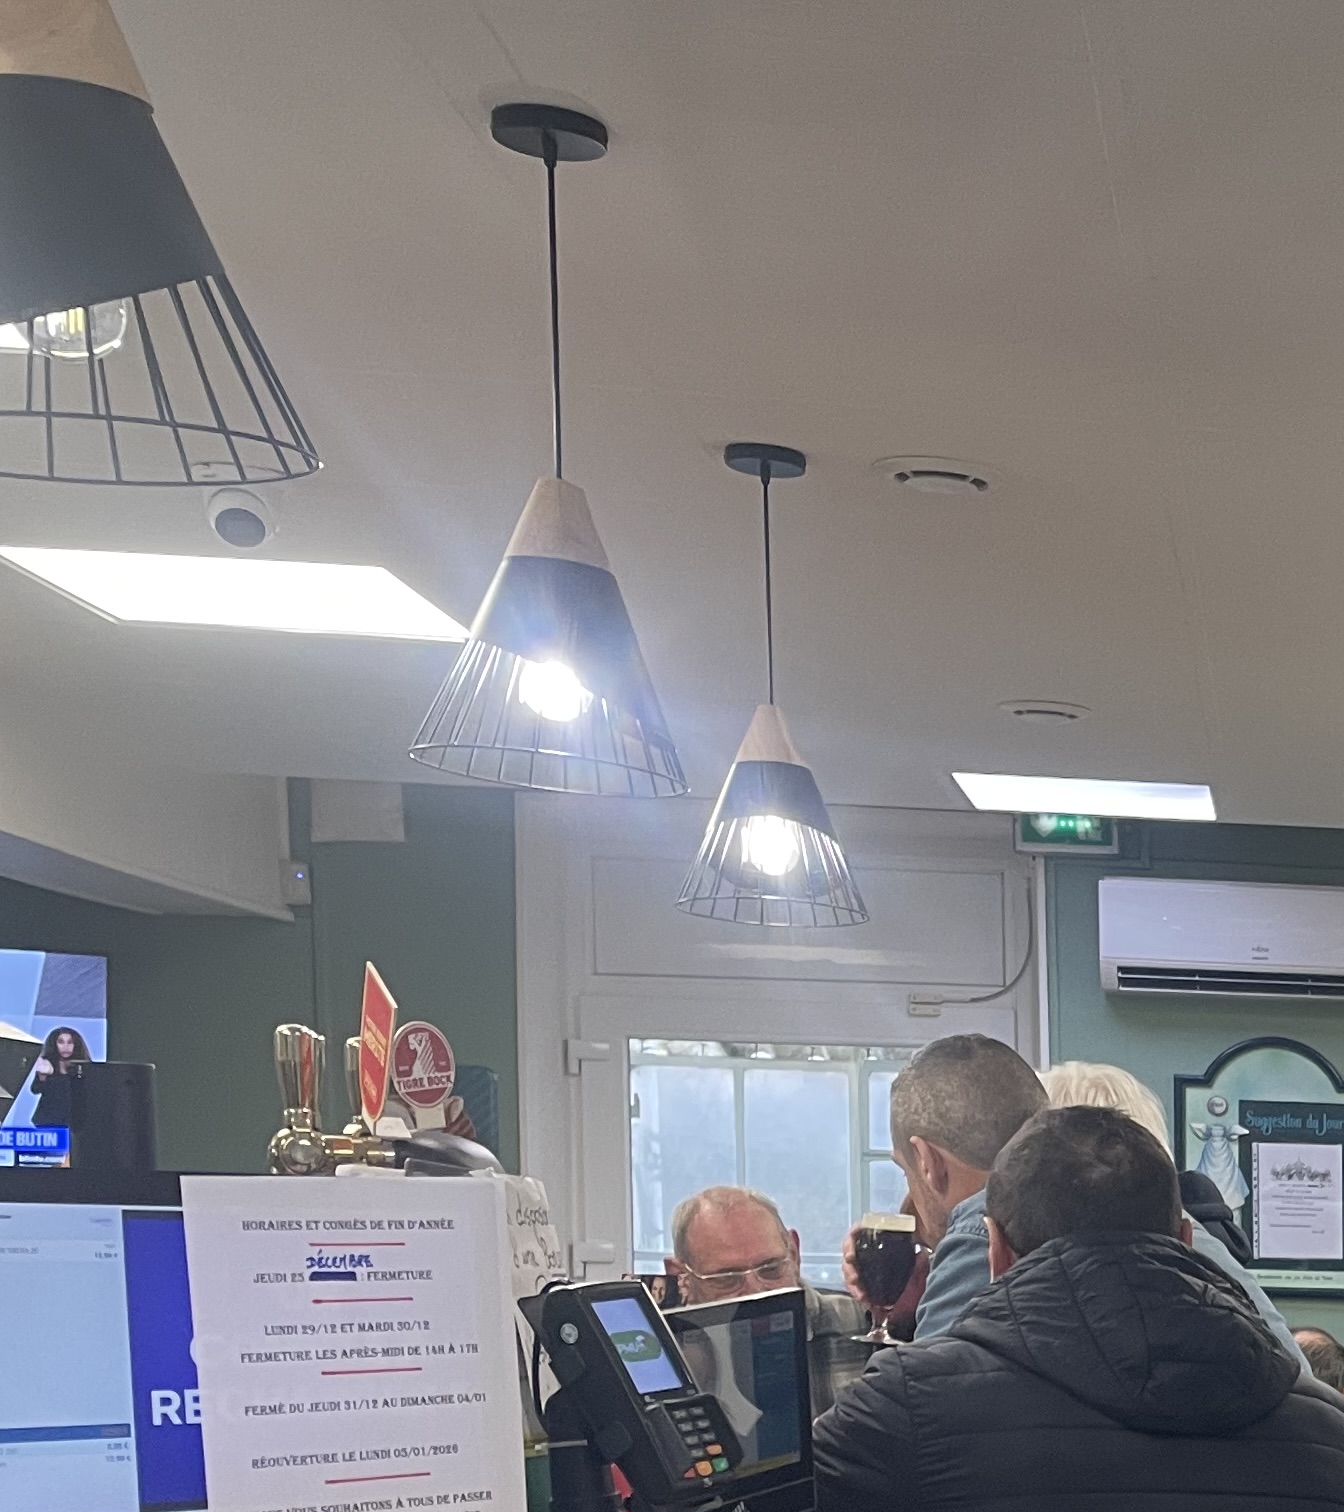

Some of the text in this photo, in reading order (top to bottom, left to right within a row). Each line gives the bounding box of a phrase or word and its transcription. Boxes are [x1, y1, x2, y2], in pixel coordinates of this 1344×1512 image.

[397, 1076, 426, 1091] TIGRE
[1246, 1110, 1344, 1136] Suggestion du Jour
[16, 1131, 57, 1146] BUTIN
[242, 1220, 303, 1231] HORAIRES
[305, 1220, 321, 1231] ET
[369, 1220, 385, 1230] DE
[387, 1220, 405, 1230] FIN
[305, 1248, 374, 1270] DÉCEMBRE
[253, 1273, 287, 1284] JEUDI
[367, 1270, 433, 1281] FERMETURE
[264, 1320, 430, 1336] LUNDI 29/12 ET MARDI 30/12
[240, 1350, 312, 1364] FERMETURE
[315, 1349, 338, 1360] LES
[340, 1345, 405, 1359] APRÈS-MIDI
[408, 1346, 420, 1356] DE
[425, 1345, 445, 1355] 14H
[460, 1343, 479, 1354] 17H
[244, 1393, 487, 1416] FERMÉ DU JEUDI 31/12 AU DIMANCHE 04/01
[251, 1451, 339, 1470] RÉOUVERTURE
[342, 1451, 357, 1462] LE
[359, 1449, 392, 1461] LUNDI
[395, 1496, 404, 1509] À
[406, 1496, 434, 1508] TOUS
[436, 1494, 450, 1505] DE
[452, 1490, 492, 1504] PASSER
